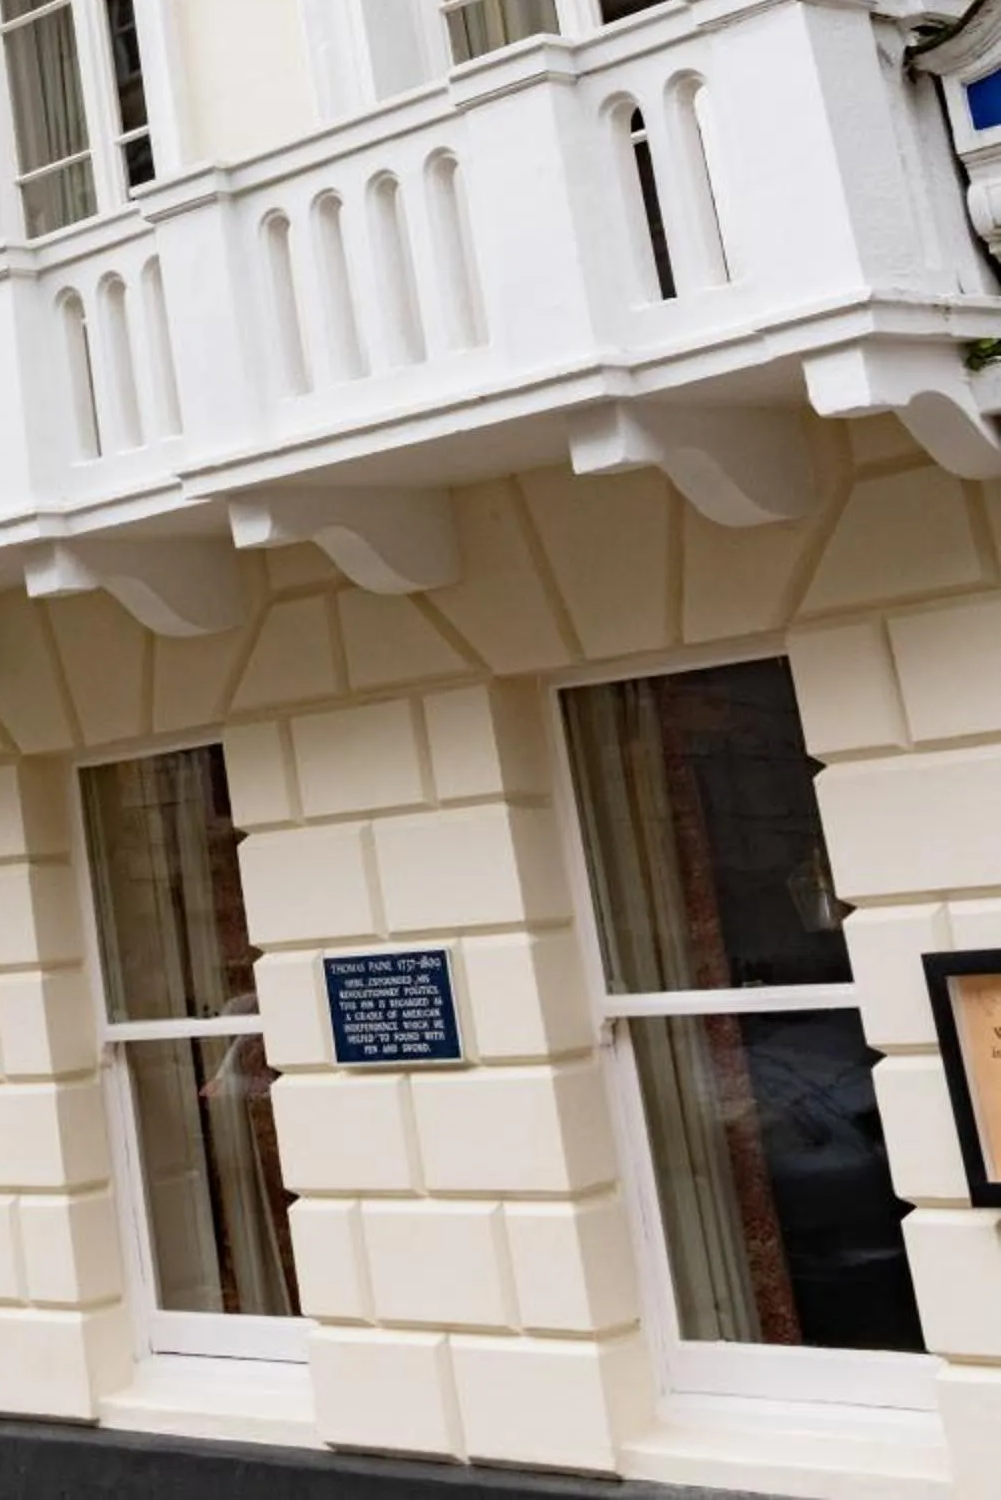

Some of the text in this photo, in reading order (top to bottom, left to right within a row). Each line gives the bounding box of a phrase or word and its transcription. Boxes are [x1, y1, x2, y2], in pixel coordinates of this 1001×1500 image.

[331, 963, 365, 975] THOMAS
[368, 960, 393, 973] PAINE
[339, 988, 399, 999] REVOLUTIONARY
[339, 1001, 357, 1011] THIS
[378, 999, 386, 1009] IS
[355, 1011, 384, 1021] CRADLE
[387, 1010, 397, 1019] OF
[402, 1008, 441, 1019] AMERICAN
[343, 1022, 399, 1033] INDEPENDENCE
[403, 1020, 428, 1031] WHICH
[380, 1032, 389, 1042] TO
[394, 1031, 420, 1042] FOUND
[424, 1030, 445, 1041] WITH
[364, 1045, 378, 1055] PEN
[382, 1044, 398, 1054] AND
